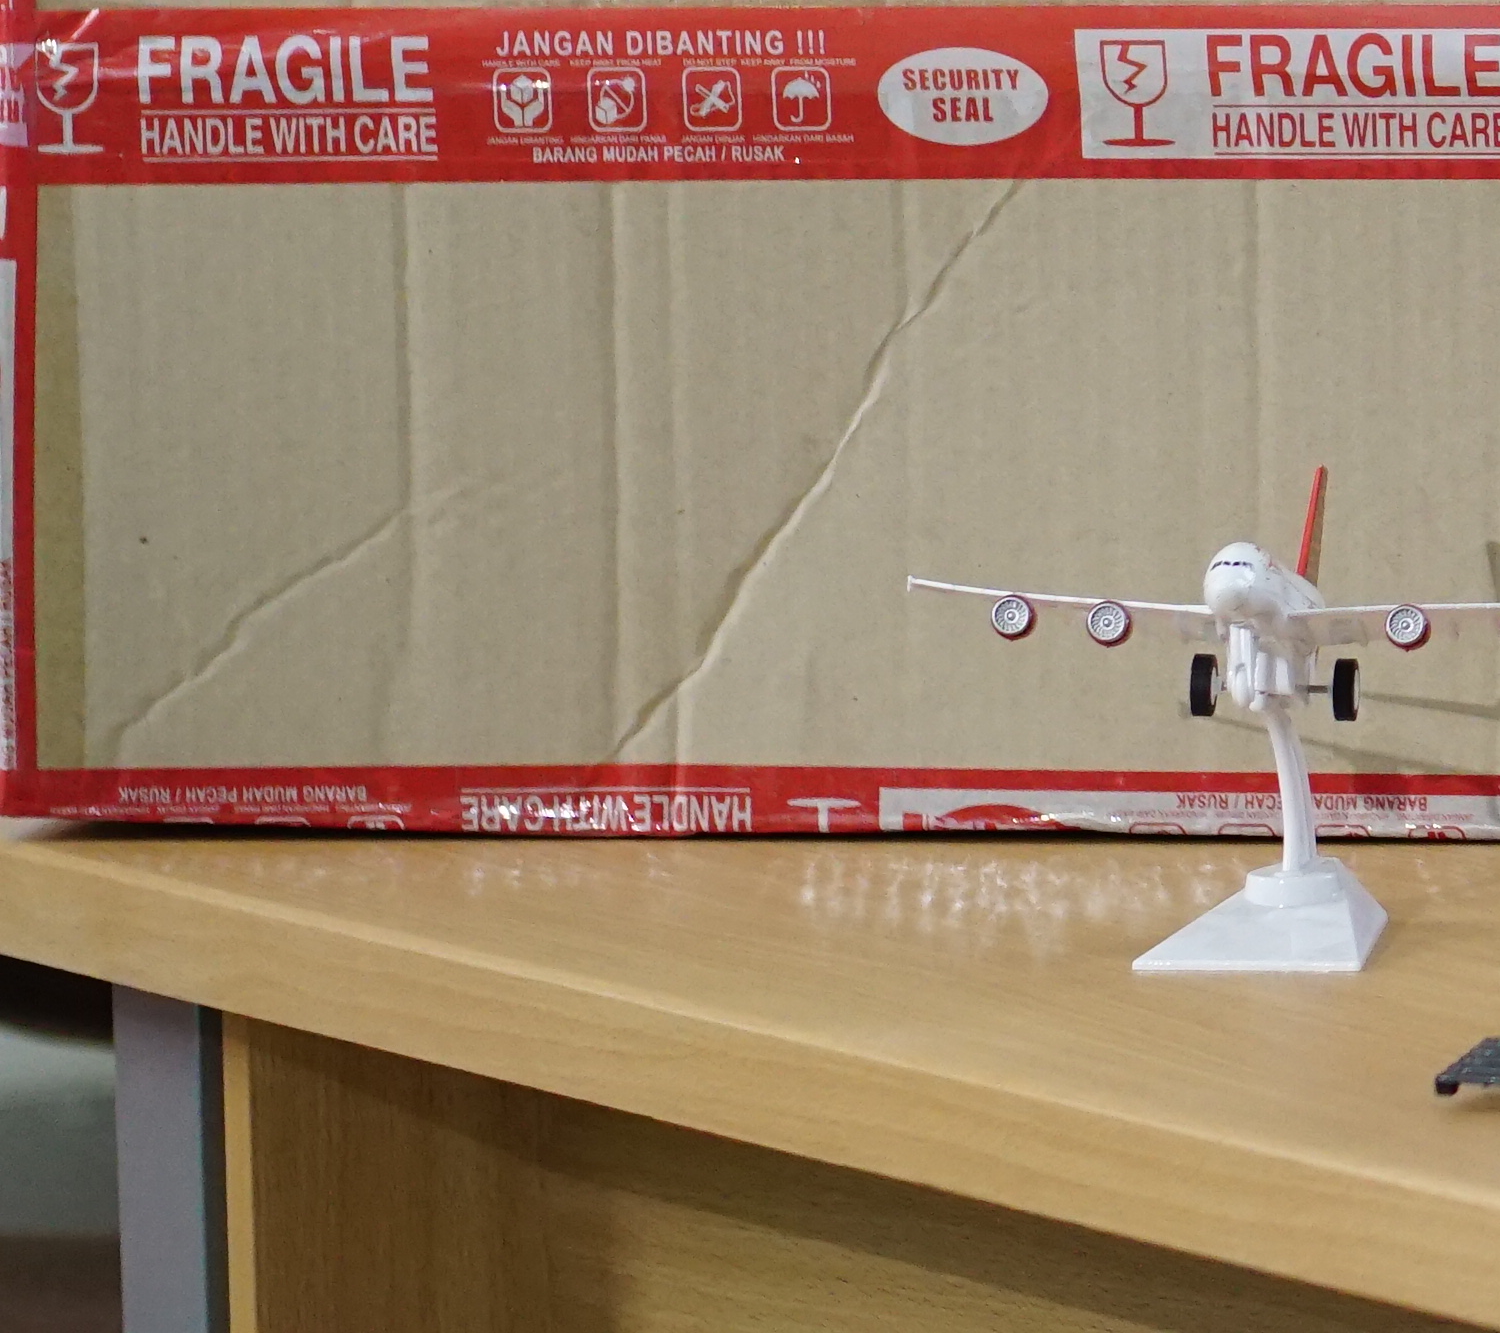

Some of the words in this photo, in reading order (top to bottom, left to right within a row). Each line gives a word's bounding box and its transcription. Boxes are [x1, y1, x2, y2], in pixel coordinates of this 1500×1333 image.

[495, 29, 613, 56] JANGAN
[626, 29, 784, 56] DIBANTING
[137, 33, 434, 105] FRAGILE
[902, 67, 1020, 92] SECURITY
[932, 96, 994, 124] SEAL
[140, 114, 264, 156] HANDLE
[269, 114, 350, 156] WITH
[354, 114, 438, 156] CARE
[1212, 111, 1336, 149] HANDLE
[1341, 111, 1419, 149] WITH
[533, 145, 598, 163] BARANG
[602, 145, 658, 163] MUDAH
[663, 145, 716, 163] PECAH
[731, 145, 785, 163] RUSAK
[118, 785, 171, 803] RUSAK
[185, 785, 237, 803] PECAH
[242, 785, 298, 803] MUDAH
[303, 785, 368, 803] BARANG
[1176, 793, 1229, 811] RUSAK
[1244, 793, 1283, 811] ECAH
[1314, 795, 1357, 811] MUDA
[1364, 795, 1428, 812] BARANG
[459, 794, 544, 833] CARE
[632, 794, 752, 833] HANDLE
